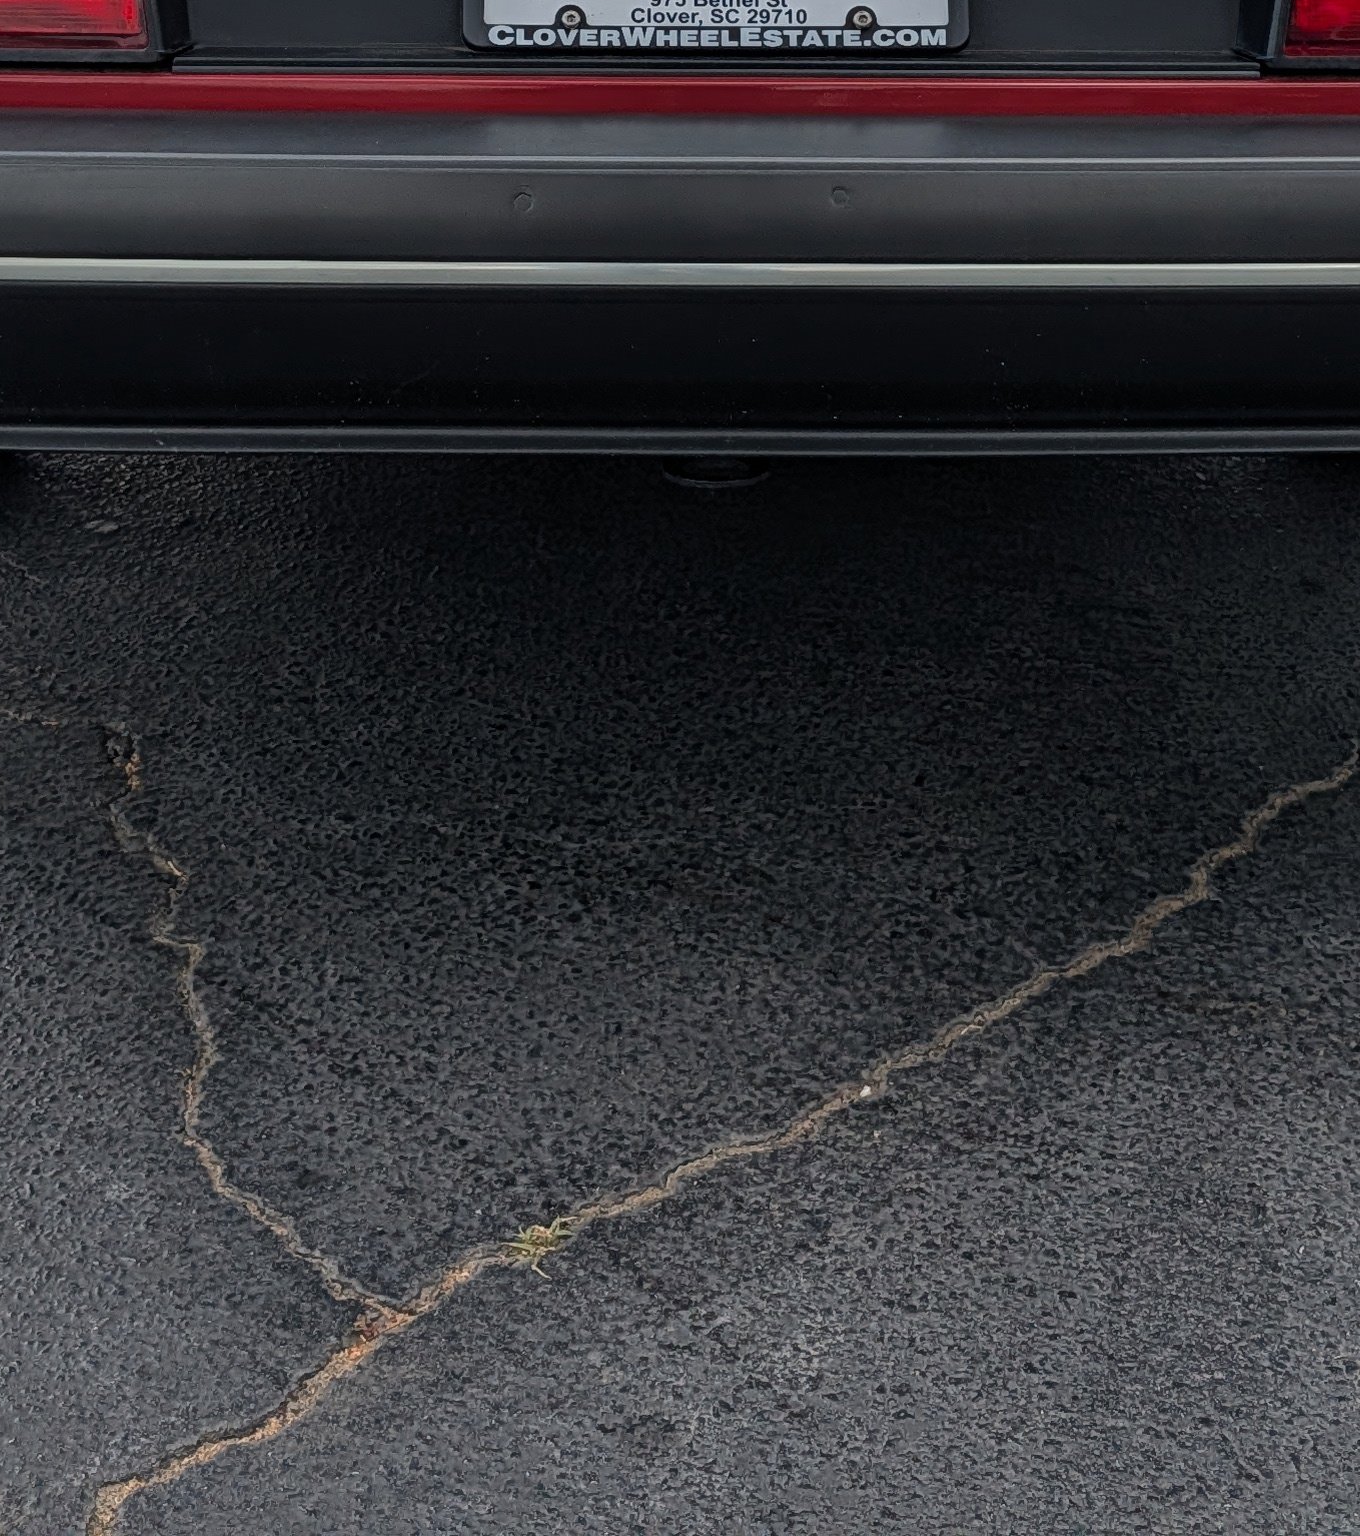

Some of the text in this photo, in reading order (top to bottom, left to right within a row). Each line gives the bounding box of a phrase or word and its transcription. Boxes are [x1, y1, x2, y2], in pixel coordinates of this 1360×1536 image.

[631, 8, 808, 26] Clover, SC 29710
